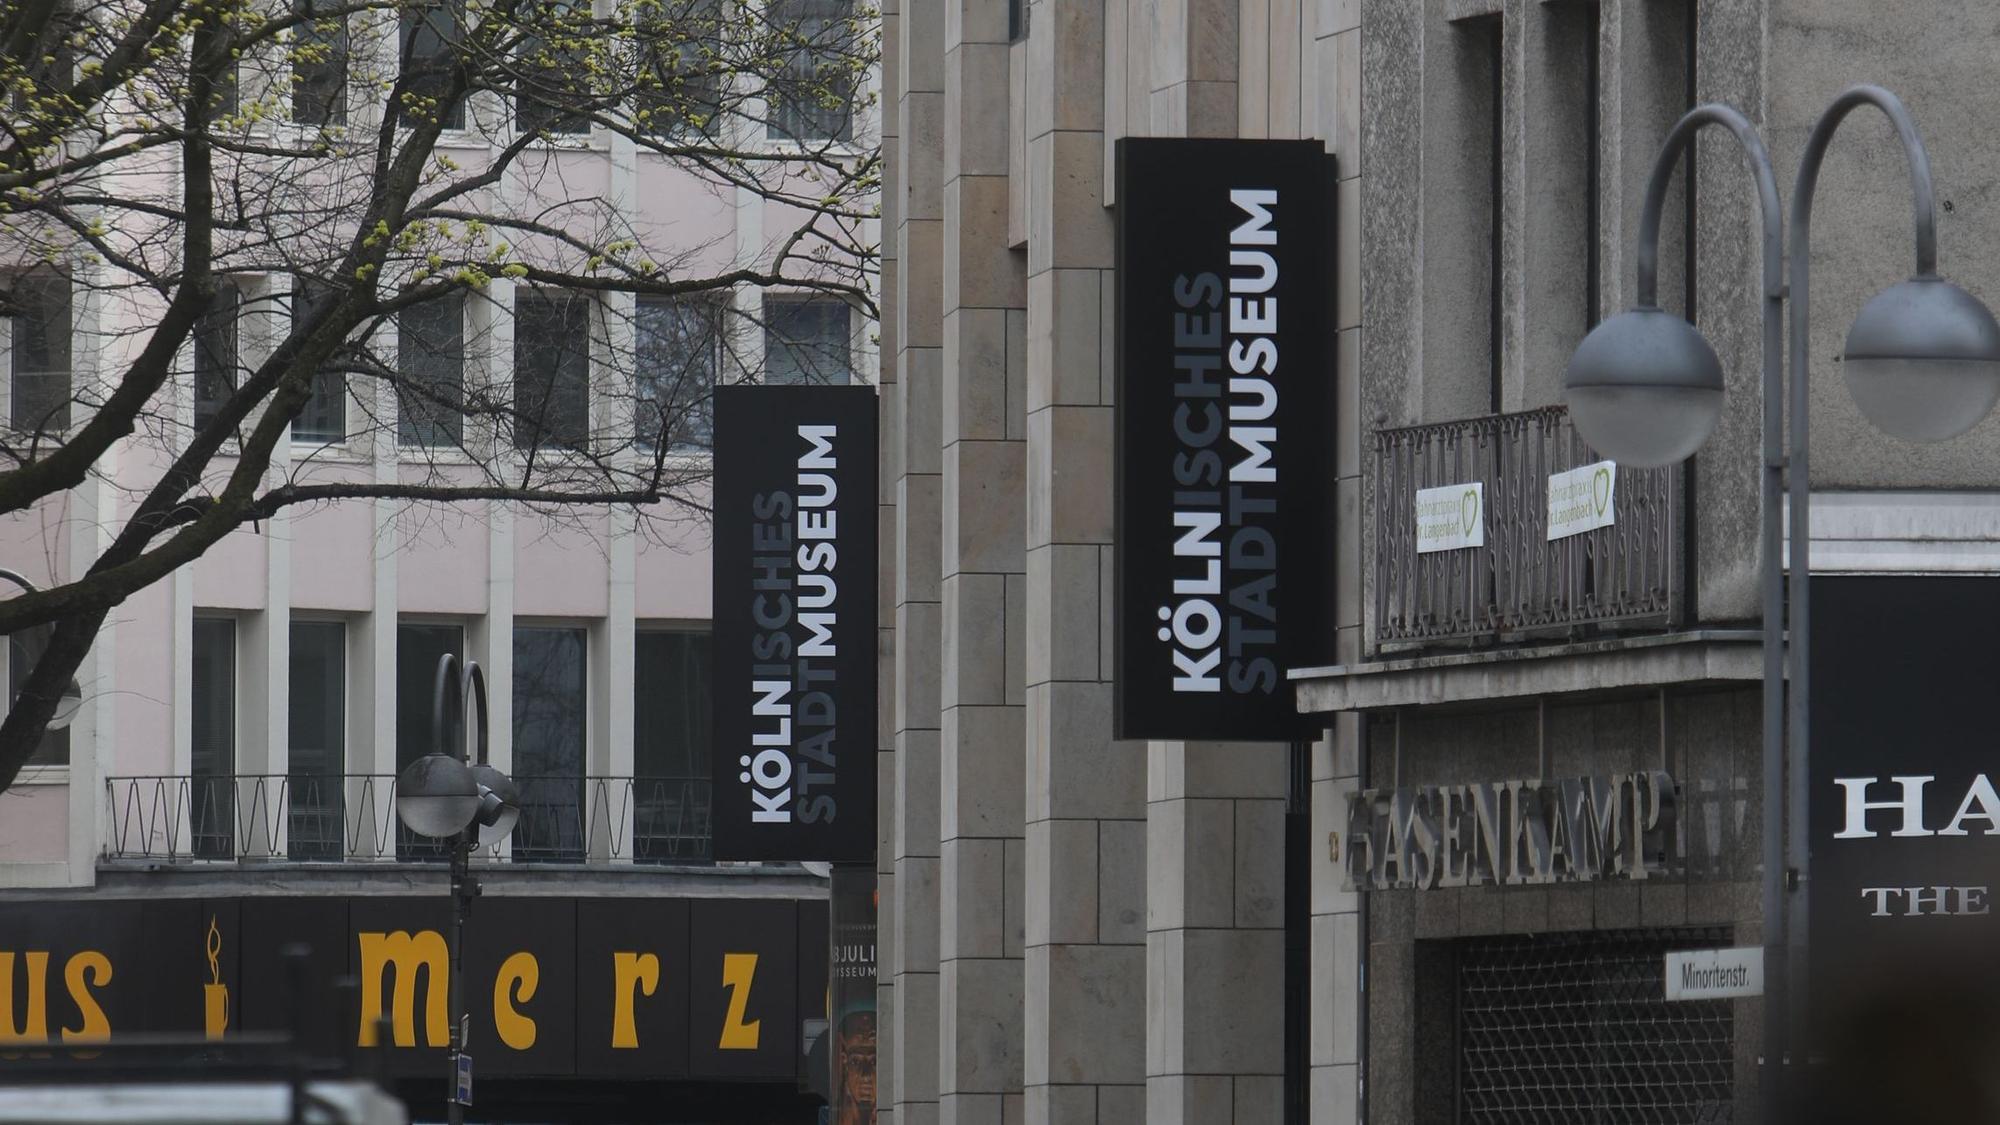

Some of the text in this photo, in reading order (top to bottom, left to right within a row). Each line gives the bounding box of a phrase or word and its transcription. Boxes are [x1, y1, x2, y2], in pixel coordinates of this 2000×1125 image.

[1157, 271, 1223, 692] KÖLNISCHES
[1229, 188, 1279, 695] STADTMUSEUM
[739, 490, 792, 823] KÖLNISCHES
[797, 425, 838, 825] STADTMUSEUM
[1834, 773, 2000, 839] HA
[1862, 886, 1990, 917] THE
[1682, 961, 1750, 990] Minoritenstr.
